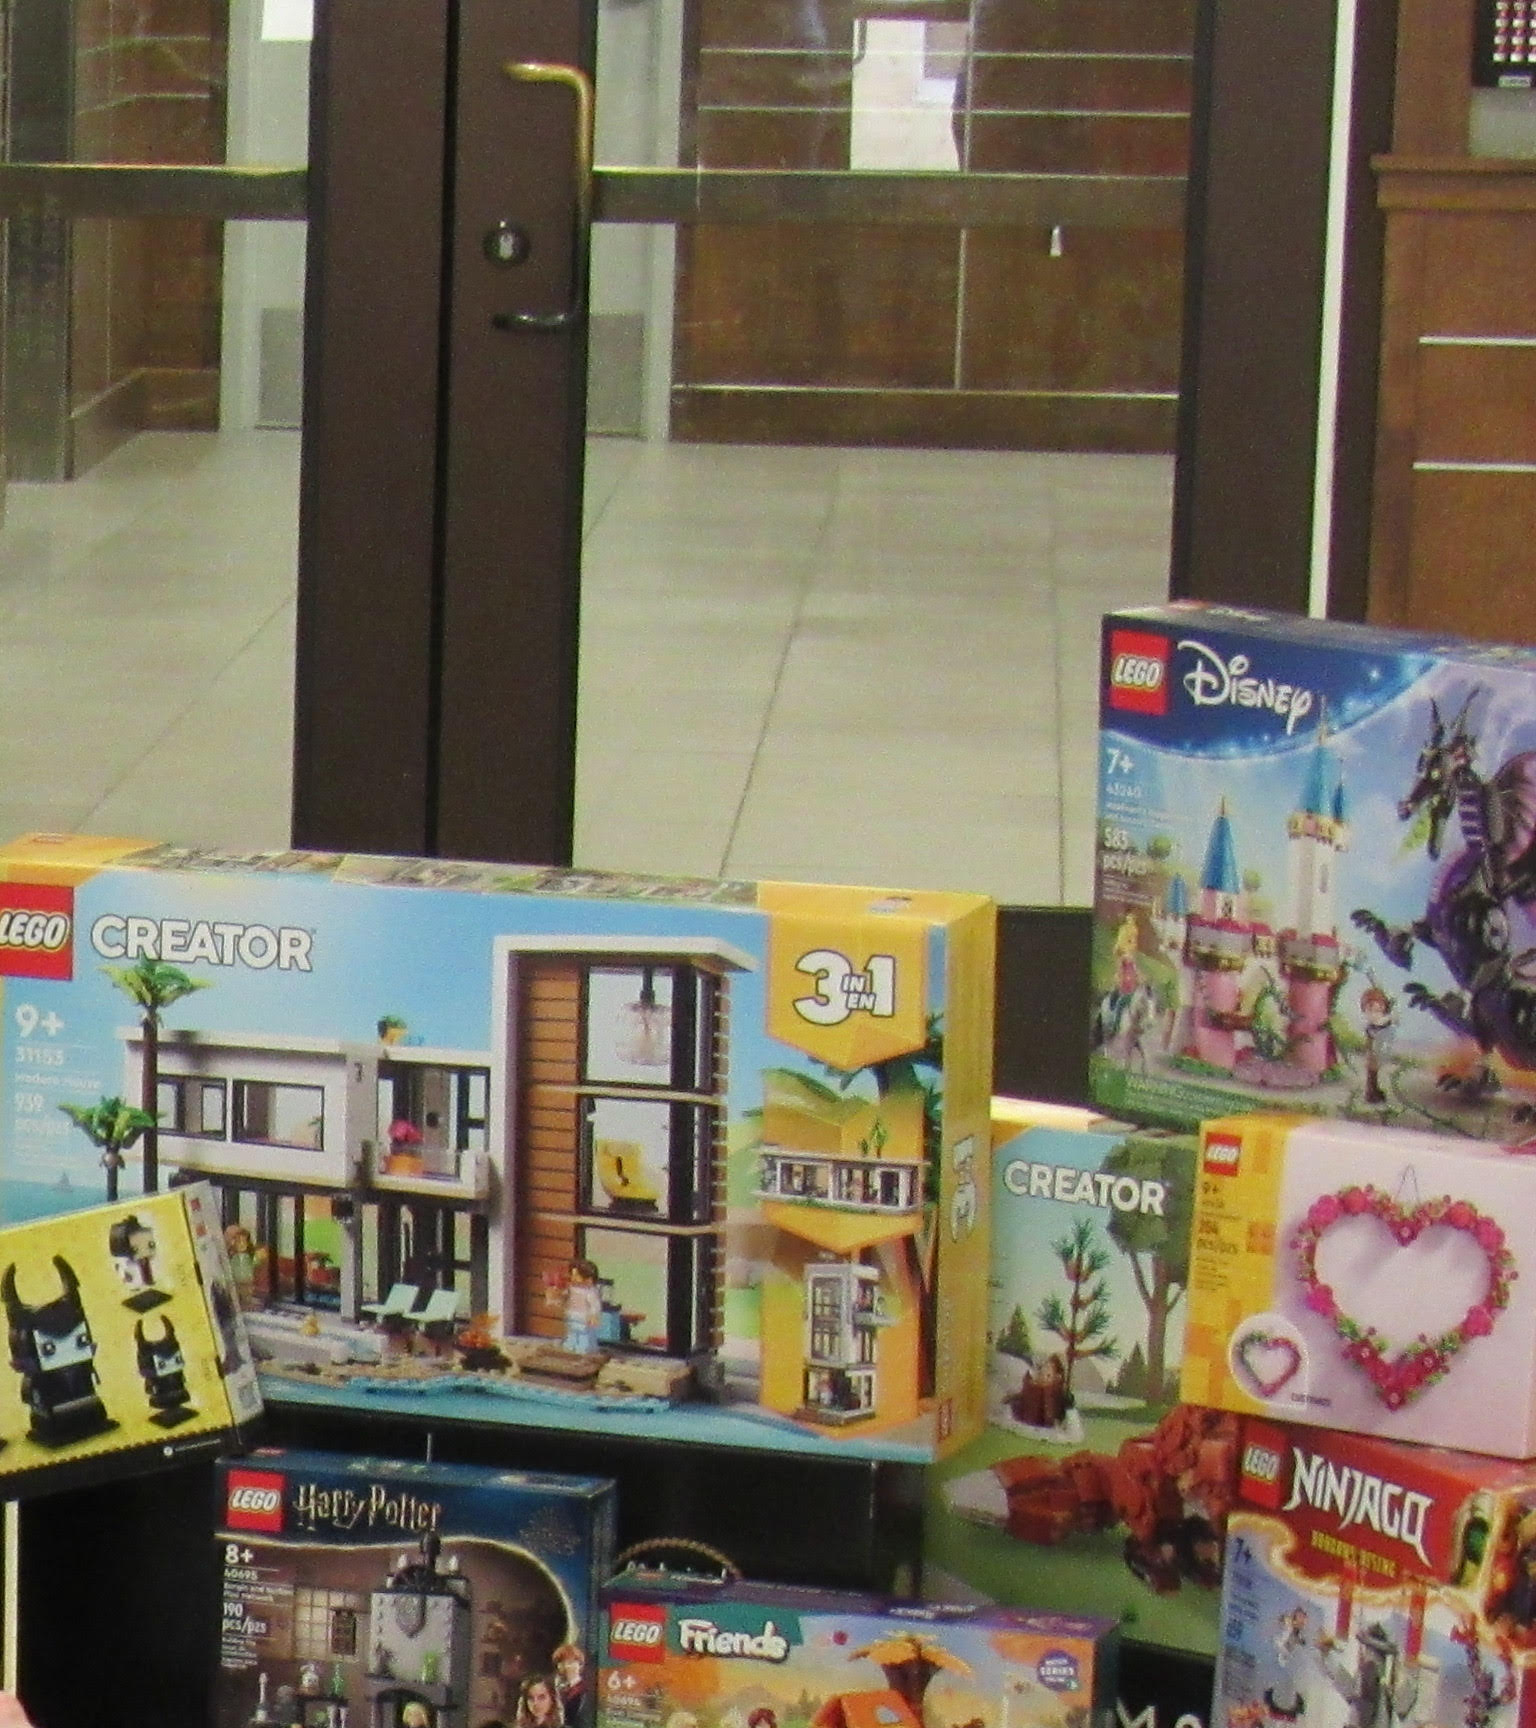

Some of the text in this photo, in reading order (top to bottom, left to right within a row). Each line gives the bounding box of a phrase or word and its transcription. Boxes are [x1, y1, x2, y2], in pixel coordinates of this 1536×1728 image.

[1112, 656, 1161, 690] LEGO
[1177, 641, 1312, 734] Disney
[1106, 747, 1135, 775] 7+
[92, 915, 315, 971] CREATOR
[15, 1003, 66, 1038] 9+
[1204, 1145, 1240, 1164] LEGO
[1003, 1158, 1167, 1217] CREATOR
[1242, 1449, 1280, 1480] LEGO
[230, 1488, 280, 1514] LEGO
[298, 1483, 442, 1532] Harry Potter
[1283, 1445, 1435, 1567] NINJAGO
[225, 1544, 254, 1564] 8+
[223, 1603, 243, 1618] 190
[613, 1619, 661, 1646] LEGO
[678, 1619, 790, 1661] Friends
